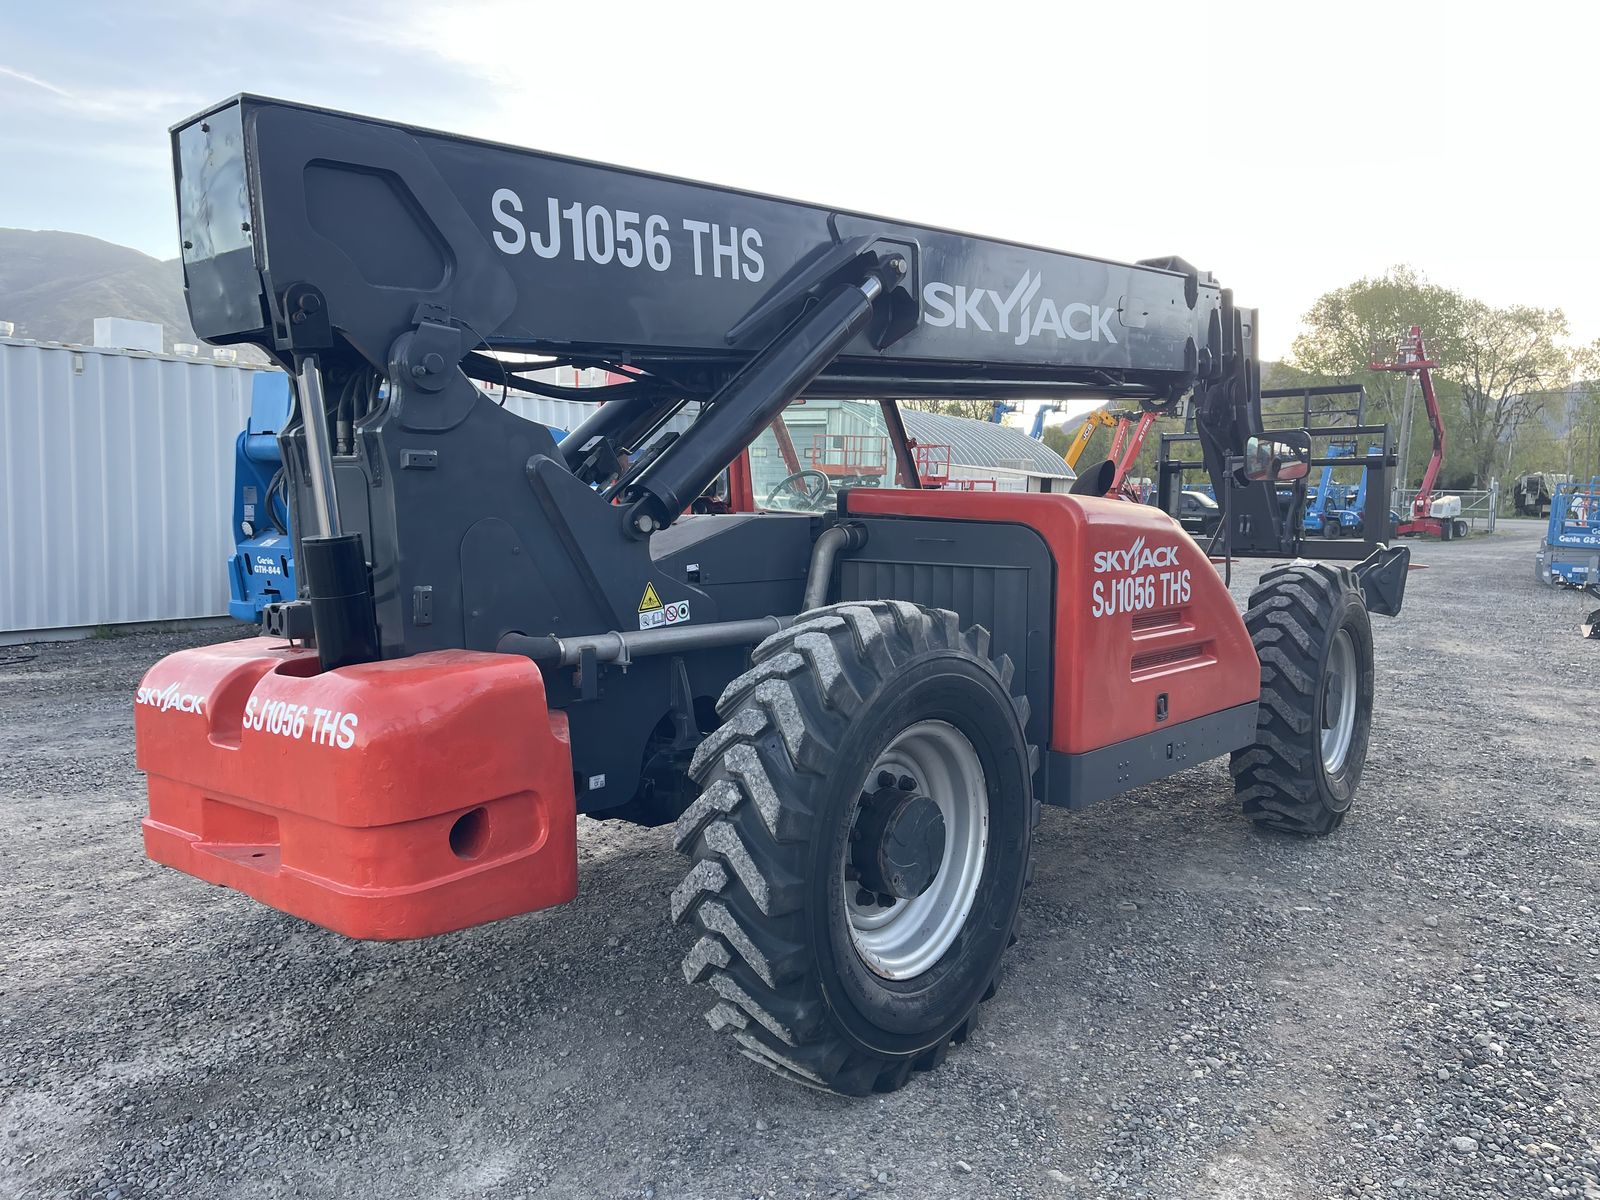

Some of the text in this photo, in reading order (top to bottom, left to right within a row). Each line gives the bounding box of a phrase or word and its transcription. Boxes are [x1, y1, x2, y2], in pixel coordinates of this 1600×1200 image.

[491, 188, 765, 283] SJ1056 THS
[923, 269, 1118, 346] SKYJACK
[1093, 535, 1180, 575] SKYJACK
[1559, 535, 1581, 543] Genie
[254, 564, 281, 575] GTH-844
[256, 556, 275, 565] Genie
[1092, 569, 1191, 618] SJ1056 THS
[136, 681, 205, 714] SKYJACK
[243, 696, 359, 750] SJ1056 THS
